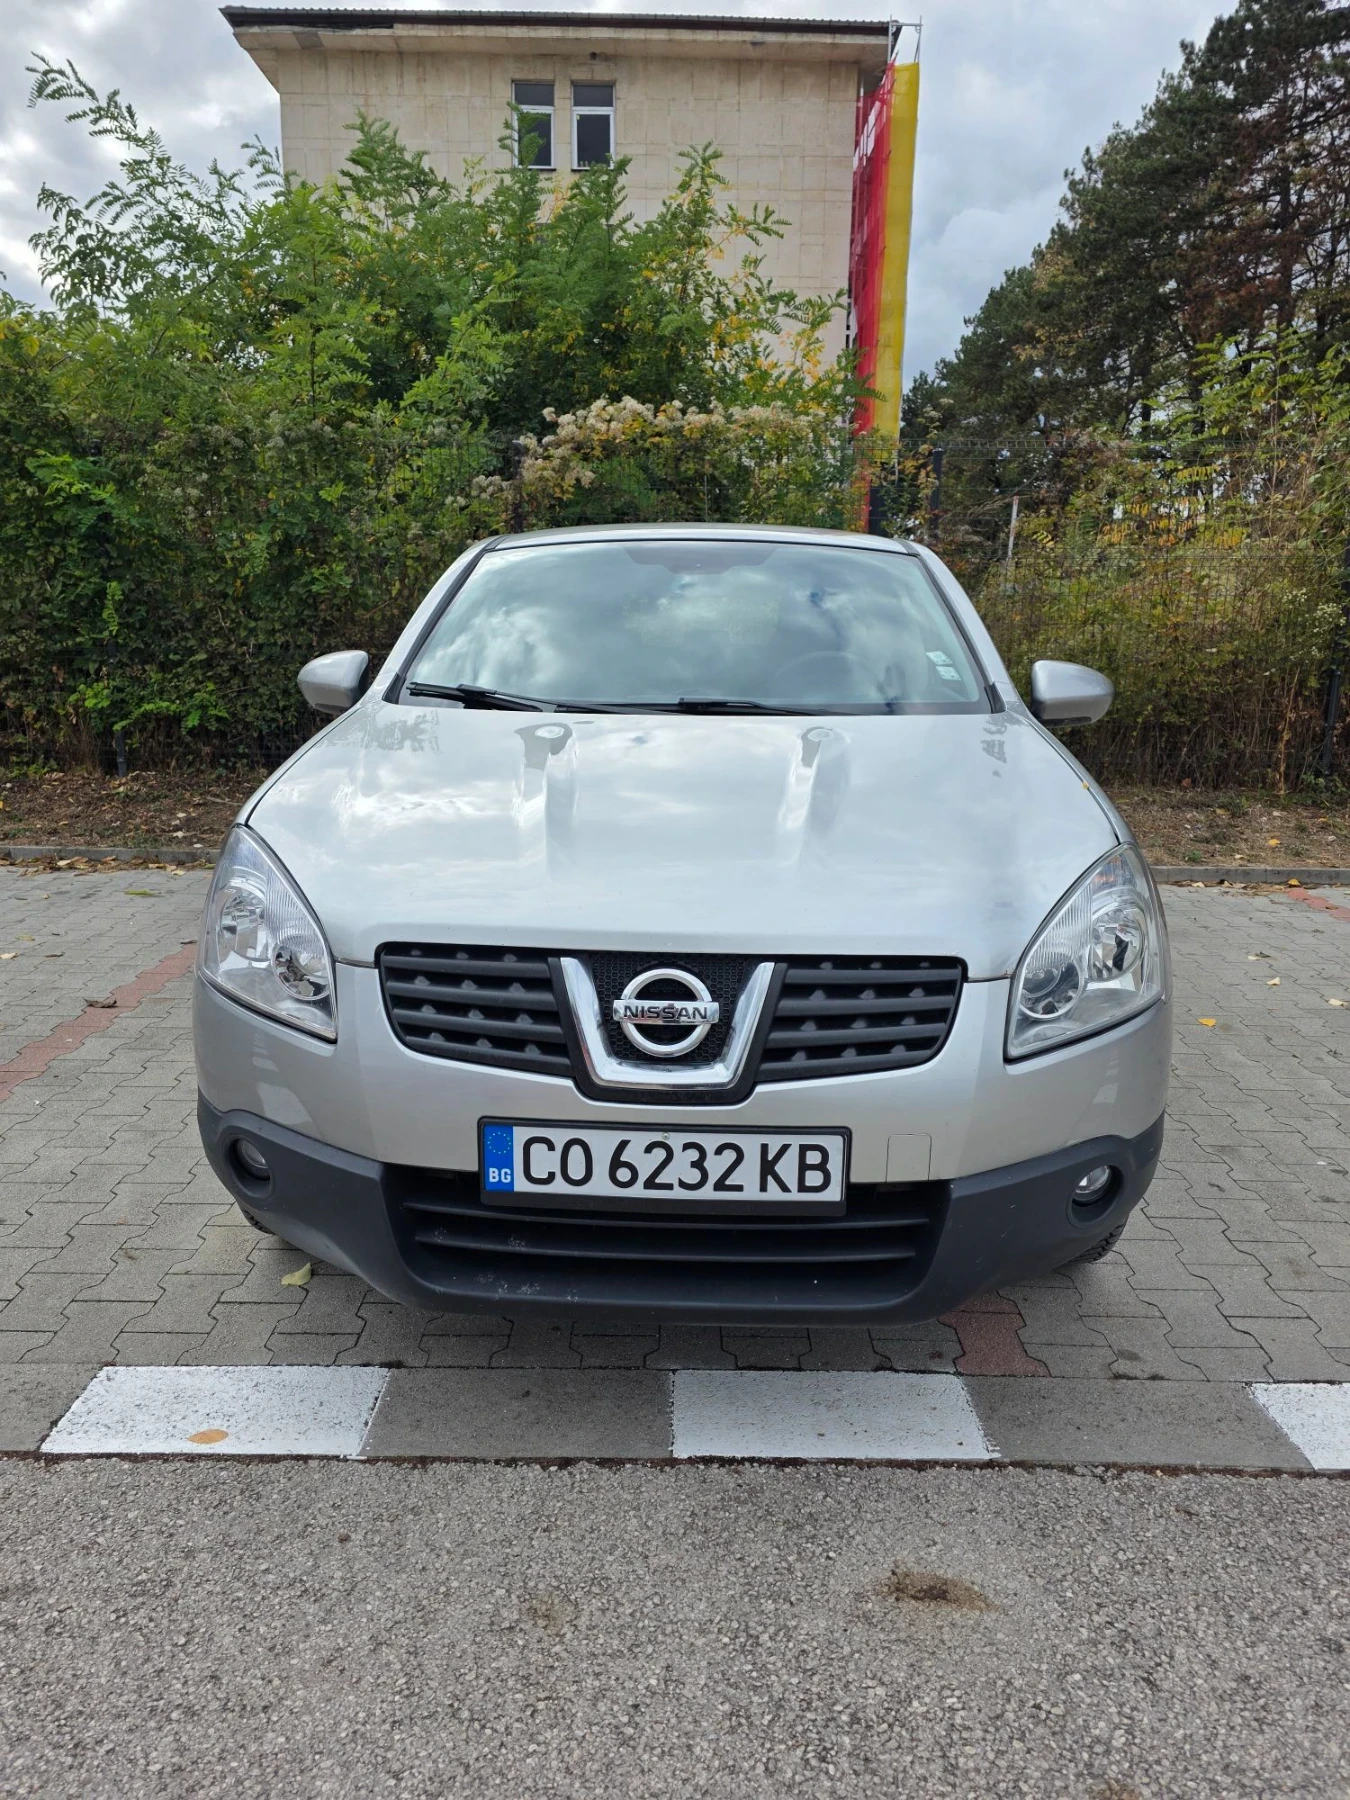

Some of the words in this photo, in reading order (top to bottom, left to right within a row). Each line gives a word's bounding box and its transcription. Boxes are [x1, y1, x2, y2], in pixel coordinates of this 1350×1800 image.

[623, 1004, 709, 1020] NISSAN
[608, 1139, 745, 1192] 6232
[759, 1142, 832, 1194] KB
[489, 1167, 512, 1184] BG
